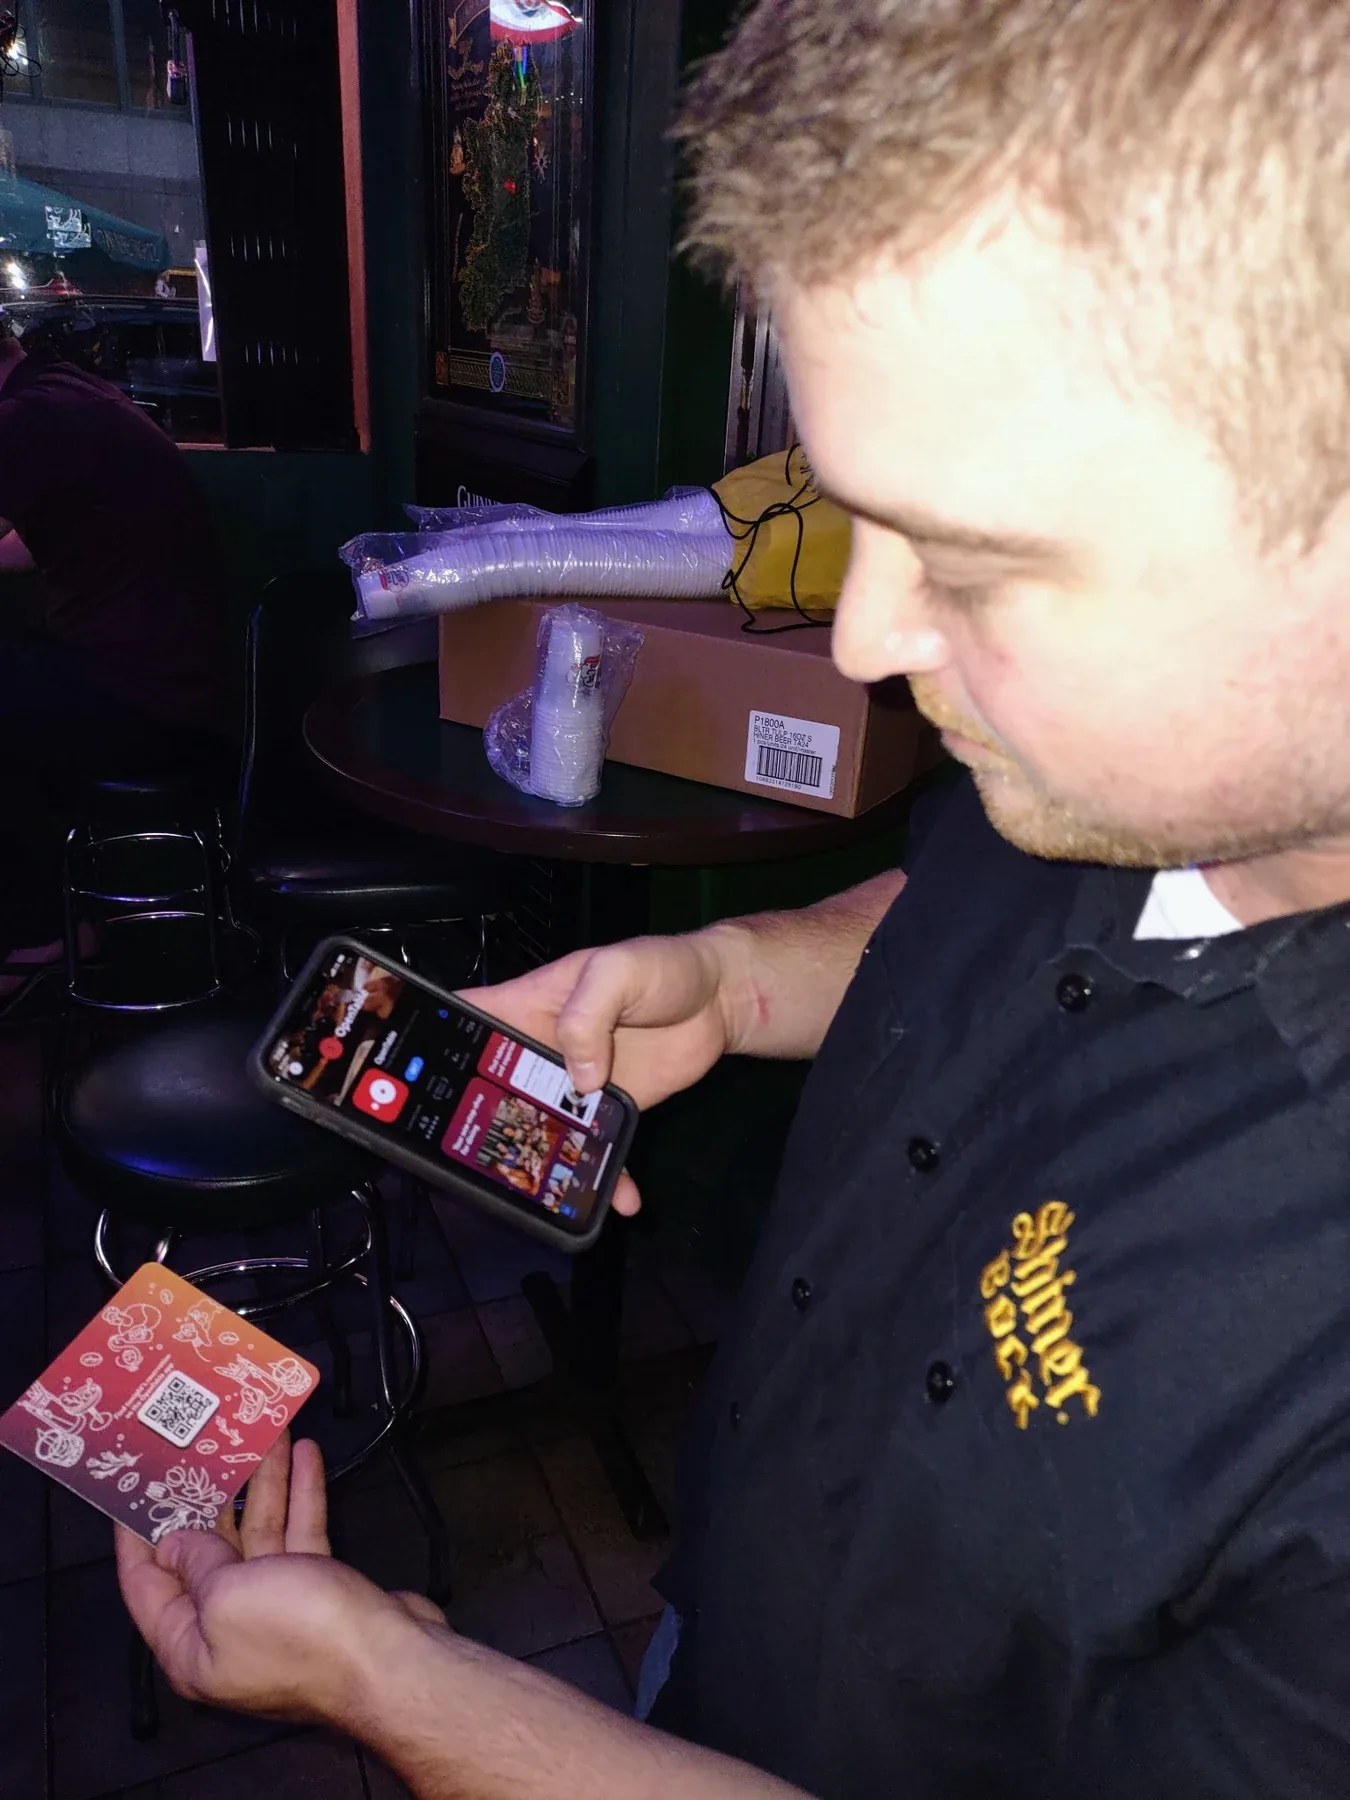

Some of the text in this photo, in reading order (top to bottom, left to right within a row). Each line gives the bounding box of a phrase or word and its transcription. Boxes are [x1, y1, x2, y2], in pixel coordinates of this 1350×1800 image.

[754, 715, 785, 729] P1800A
[753, 732, 773, 742] HINER
[774, 735, 792, 746] BEER
[807, 734, 812, 743] S
[332, 986, 370, 1039] OpenTable
